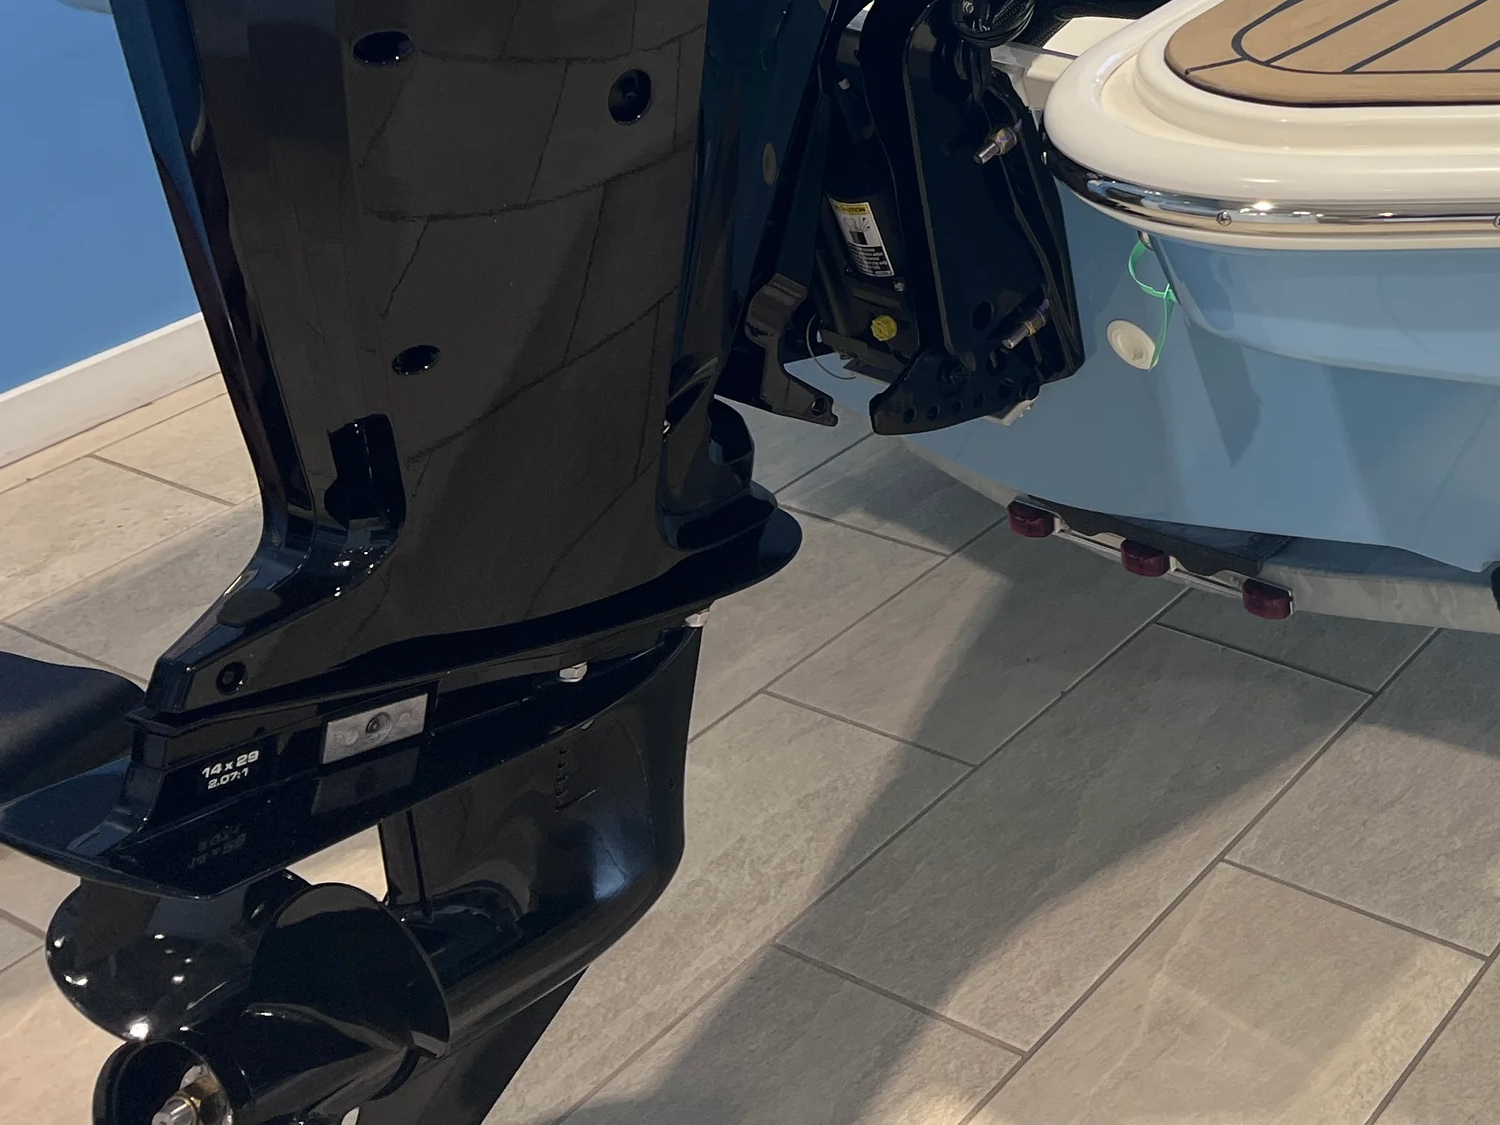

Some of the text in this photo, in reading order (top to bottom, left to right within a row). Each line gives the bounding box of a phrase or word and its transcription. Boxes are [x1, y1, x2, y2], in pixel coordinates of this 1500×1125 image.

[202, 750, 259, 778] 14 x 29
[208, 767, 249, 790] 2.07:1
